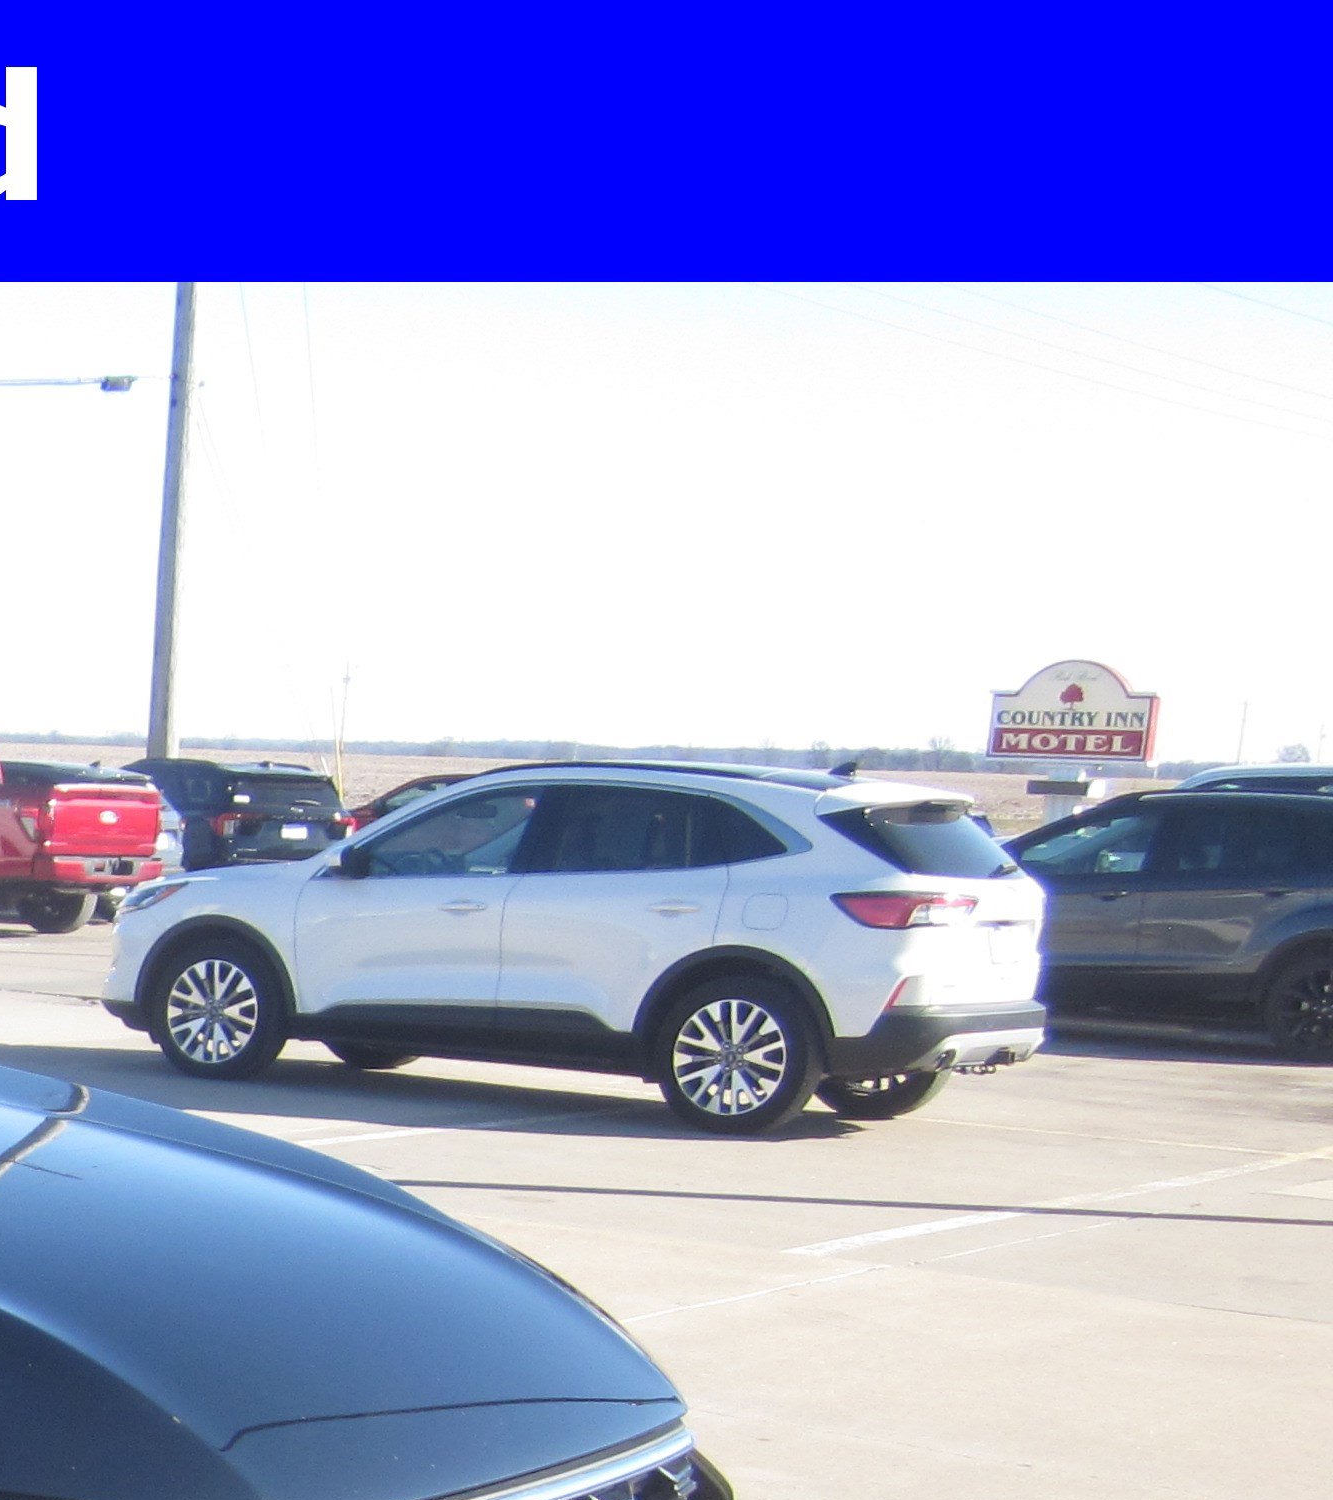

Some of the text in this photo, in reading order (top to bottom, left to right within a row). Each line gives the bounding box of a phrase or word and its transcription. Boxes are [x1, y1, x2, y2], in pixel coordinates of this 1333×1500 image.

[996, 710, 1146, 728] COUNTRY INN
[1001, 732, 1135, 752] MOTEL
